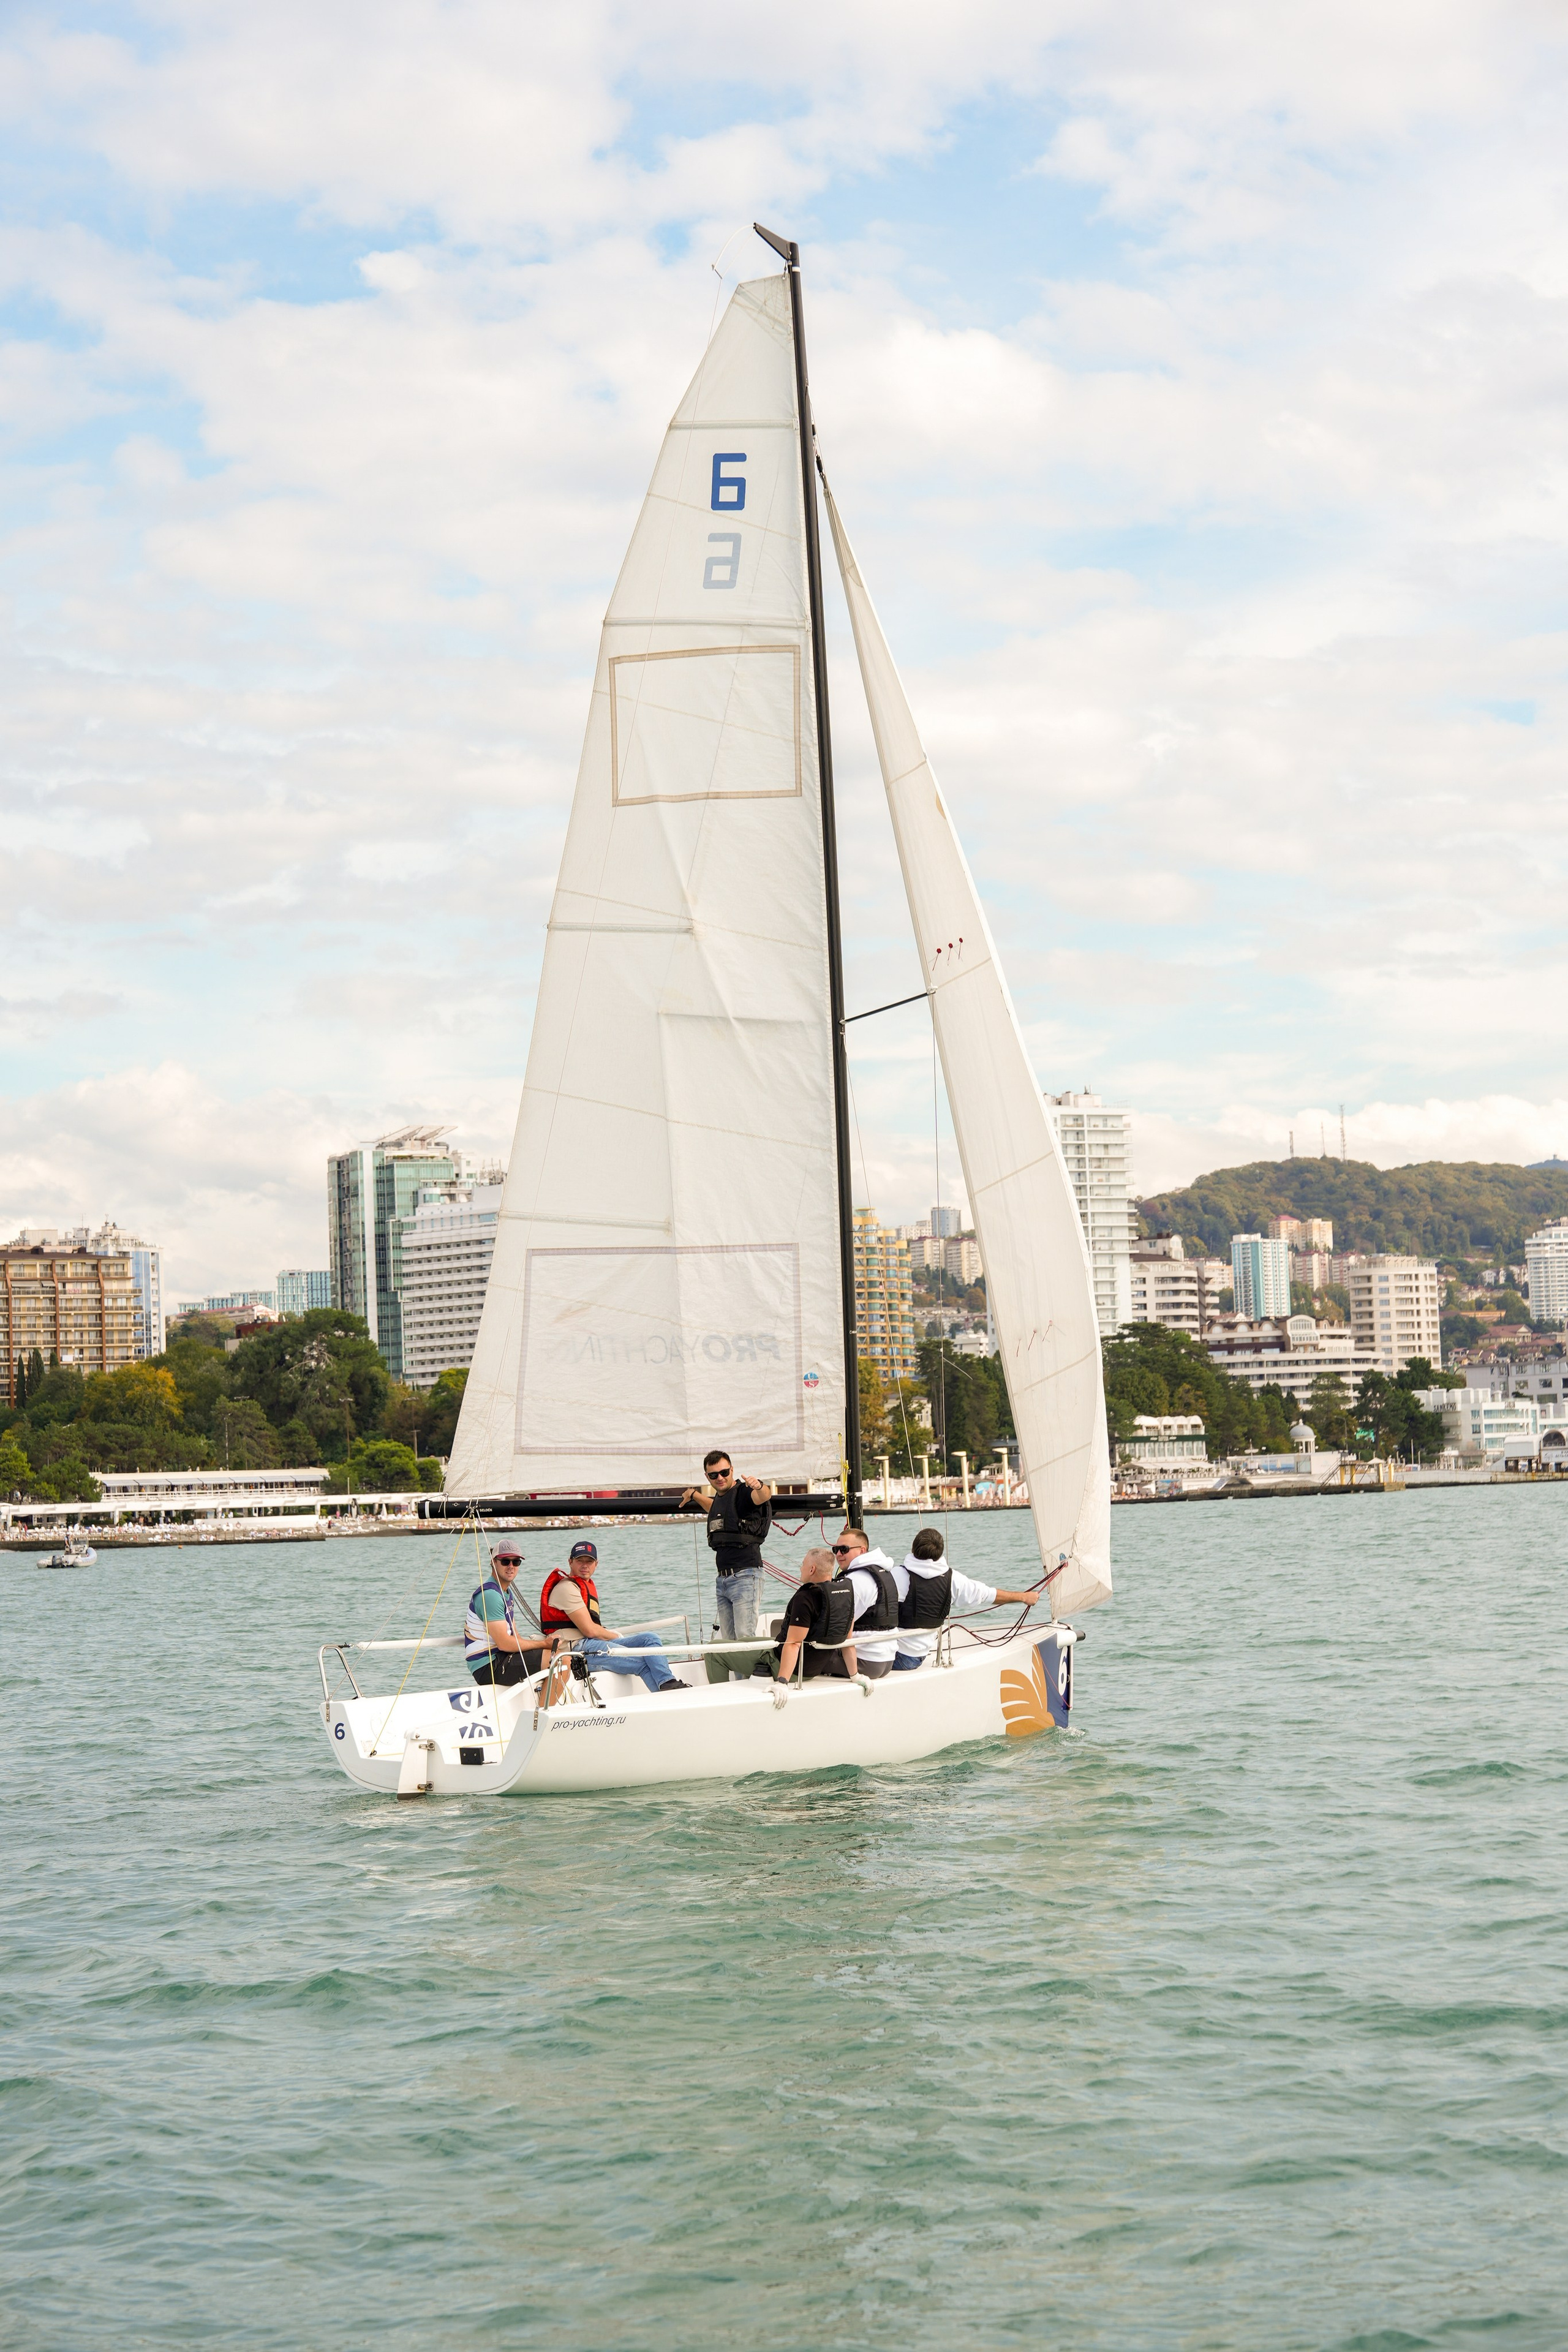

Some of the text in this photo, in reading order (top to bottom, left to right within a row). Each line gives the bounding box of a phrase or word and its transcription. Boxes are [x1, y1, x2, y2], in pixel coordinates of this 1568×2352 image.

[711, 453, 747, 510] 6
[1058, 1645, 1068, 1696] 6
[334, 1722, 345, 1740] 6
[551, 1716, 627, 1732] pro-yachting.ru
